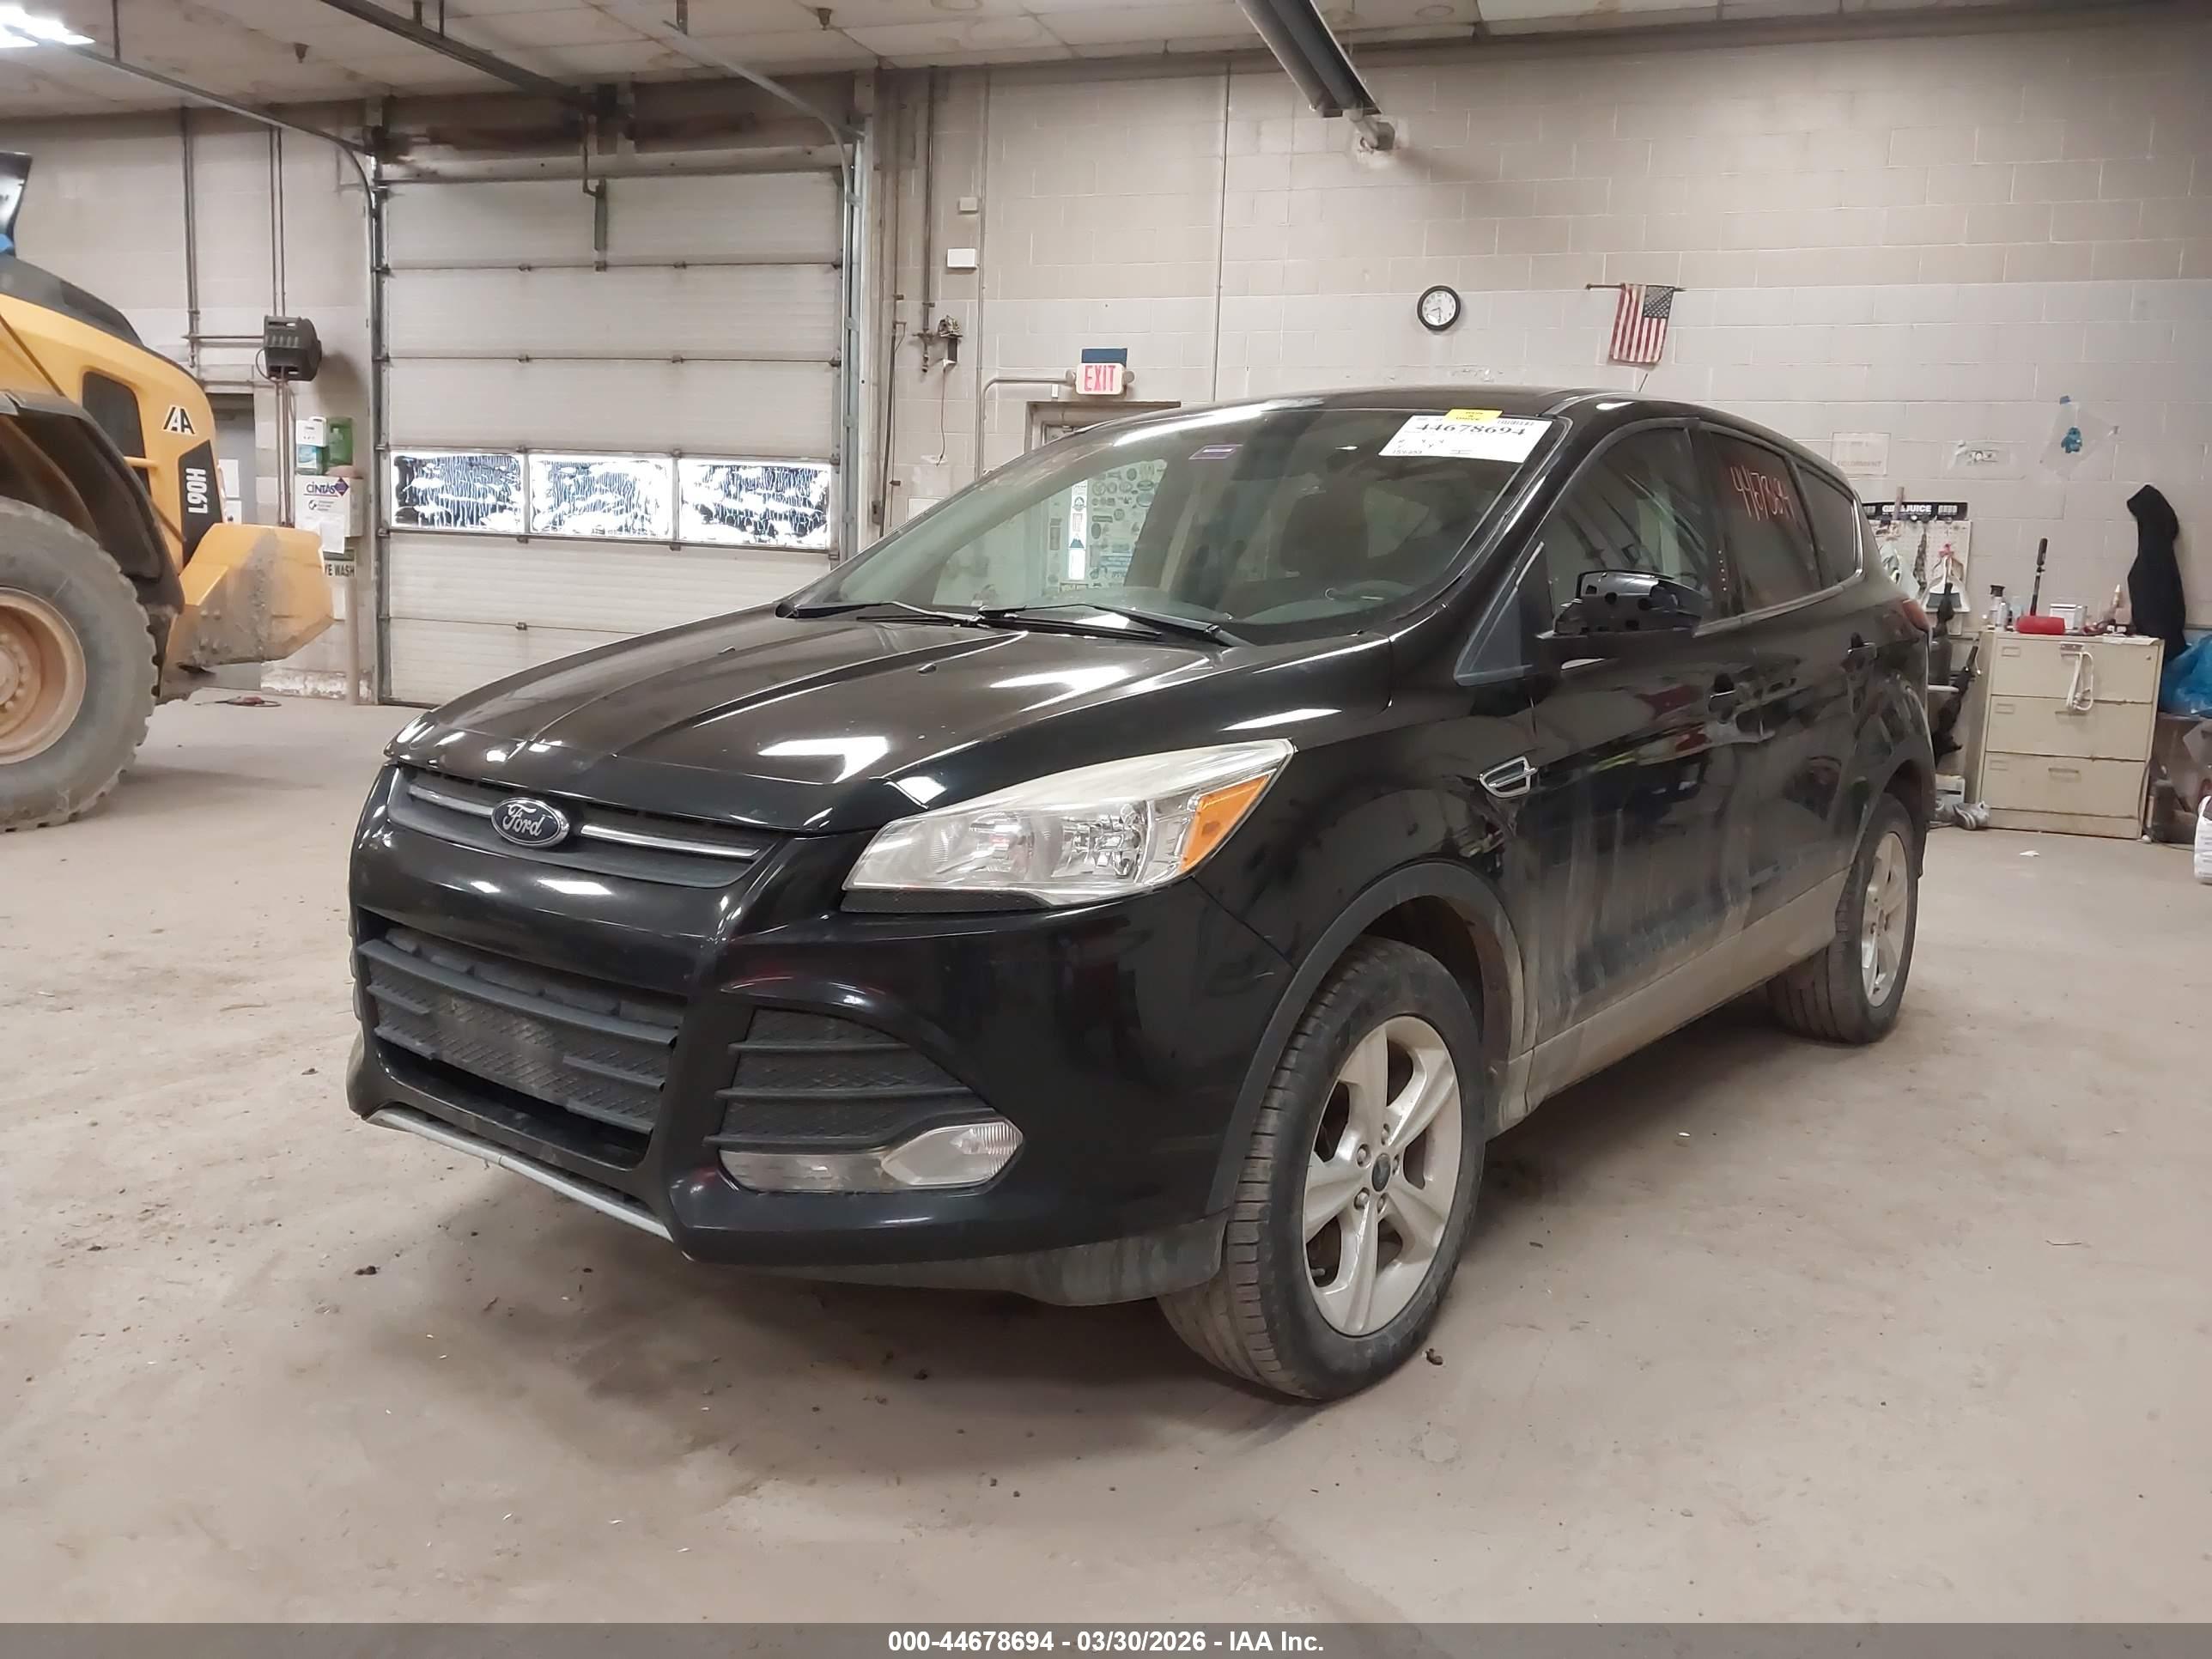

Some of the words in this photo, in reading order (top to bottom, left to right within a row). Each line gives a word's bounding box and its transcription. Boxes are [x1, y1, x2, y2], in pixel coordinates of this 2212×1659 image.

[1085, 365, 1116, 391] EXIT
[1416, 422, 1526, 437] 44678694
[185, 468, 209, 514] L90H
[334, 563, 355, 577] WASH
[502, 803, 545, 836] Ford
